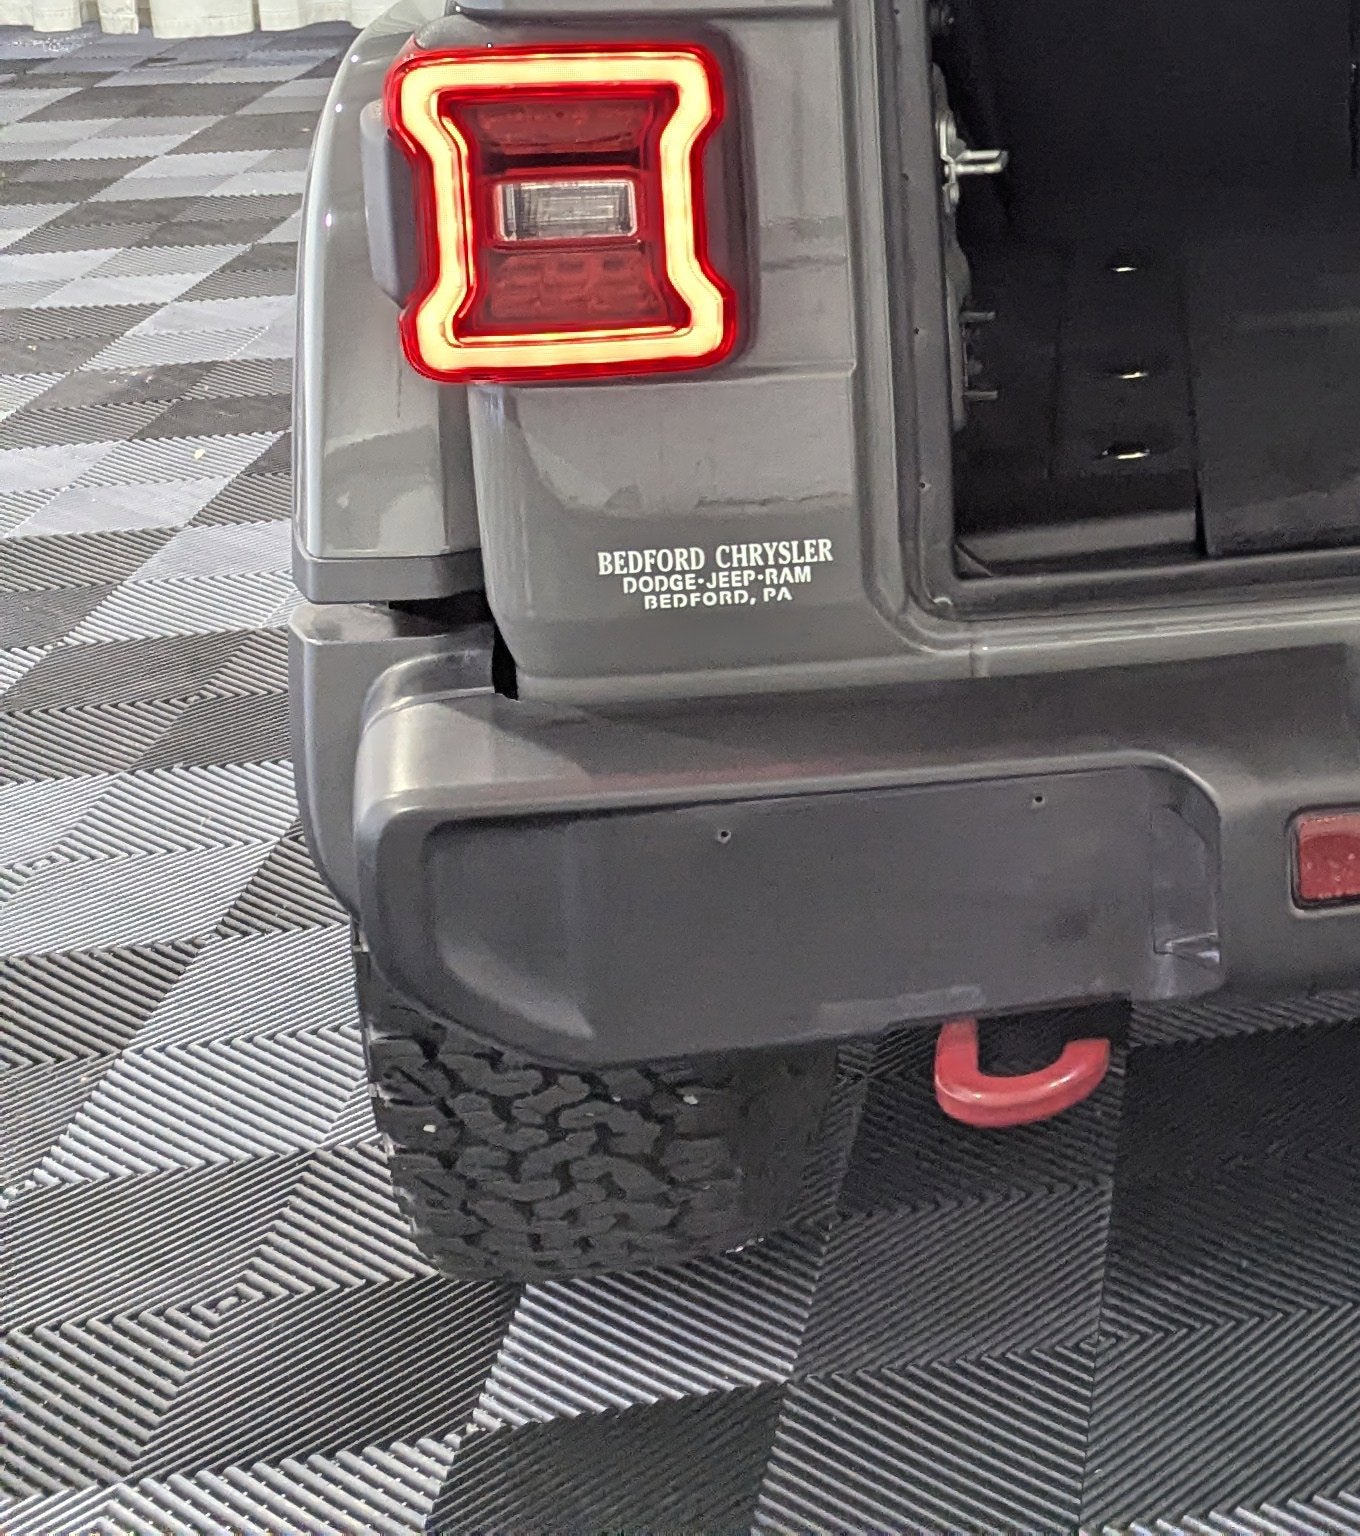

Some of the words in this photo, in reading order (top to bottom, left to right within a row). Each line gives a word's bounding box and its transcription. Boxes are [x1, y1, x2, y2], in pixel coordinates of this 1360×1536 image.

[597, 546, 706, 576] BEDFORD
[715, 537, 834, 569] CHRYSLER
[643, 588, 757, 610] BEDFORD,
[762, 586, 793, 603] PA
